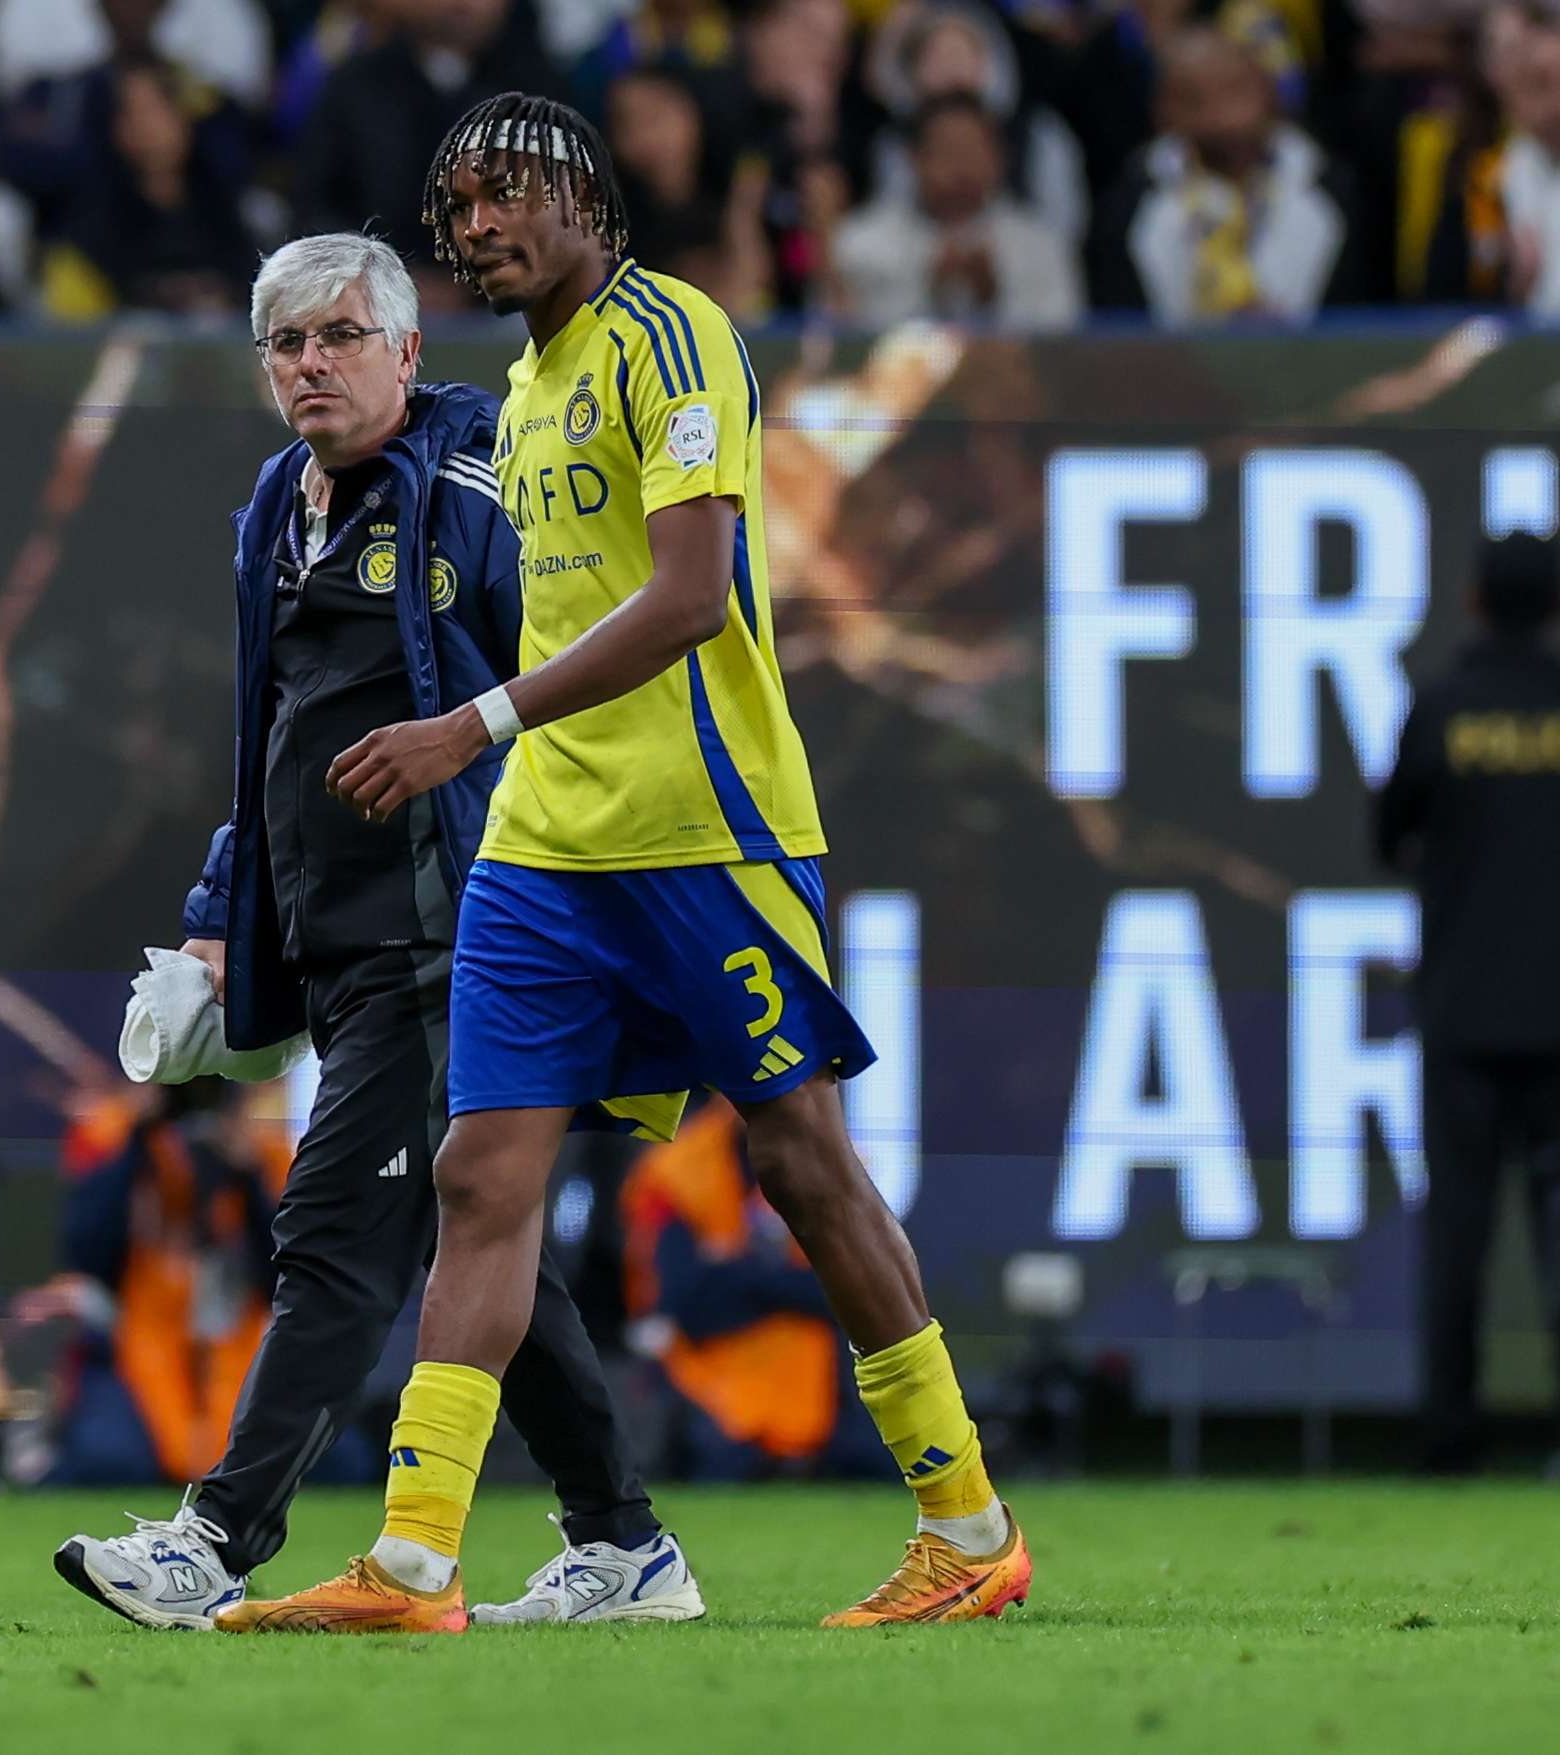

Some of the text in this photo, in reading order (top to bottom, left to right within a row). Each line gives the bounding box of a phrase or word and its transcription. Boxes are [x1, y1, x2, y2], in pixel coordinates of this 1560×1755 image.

[682, 428, 705, 444] RSL
[1044, 447, 1558, 799] FR
[723, 946, 784, 1039] 3
